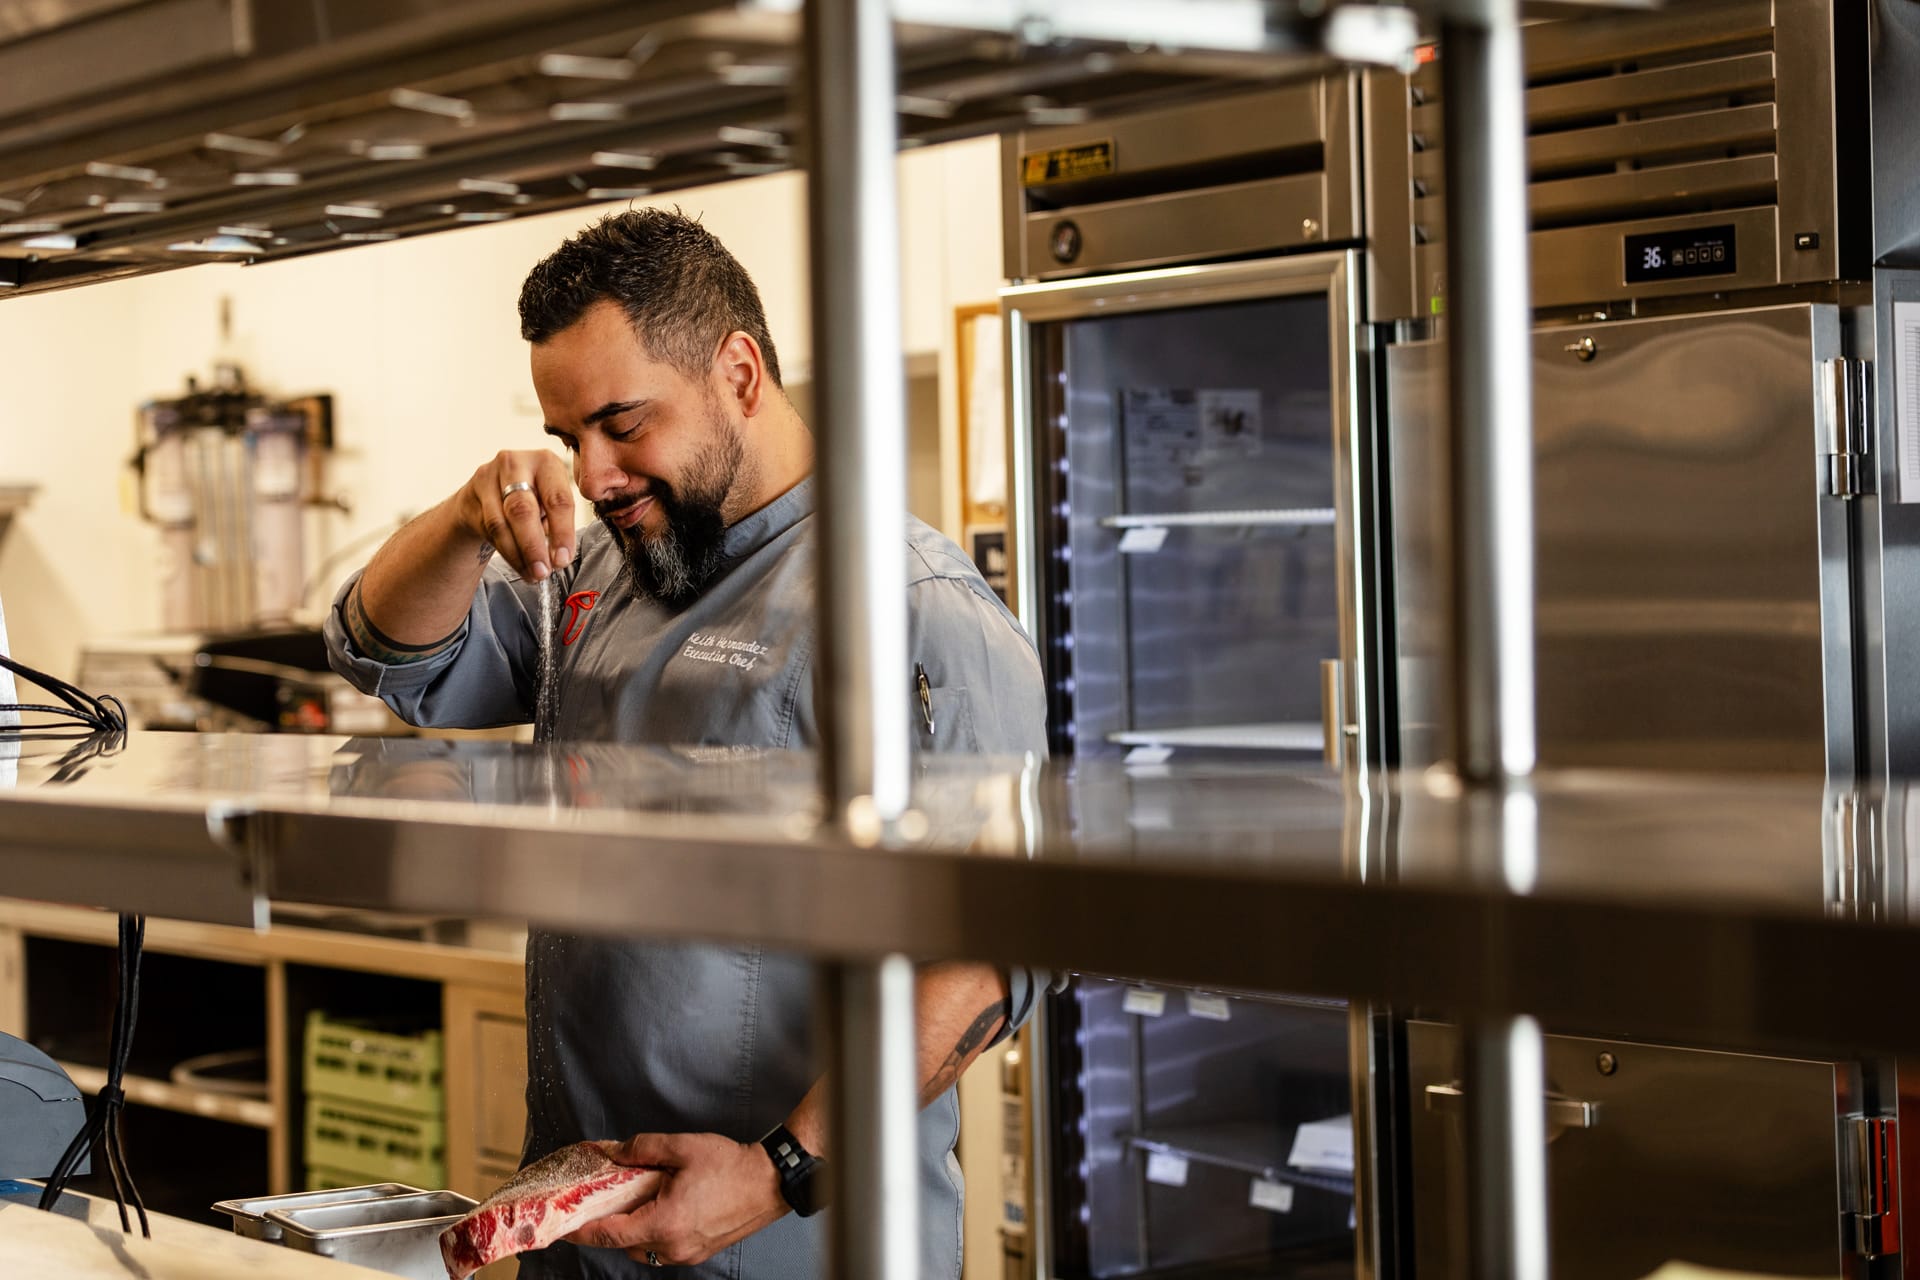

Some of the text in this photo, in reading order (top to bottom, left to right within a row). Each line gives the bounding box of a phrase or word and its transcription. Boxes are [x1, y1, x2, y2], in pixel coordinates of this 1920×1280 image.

[688, 632, 768, 655] Keith Hernandez
[683, 646, 757, 671] Executive Chef
